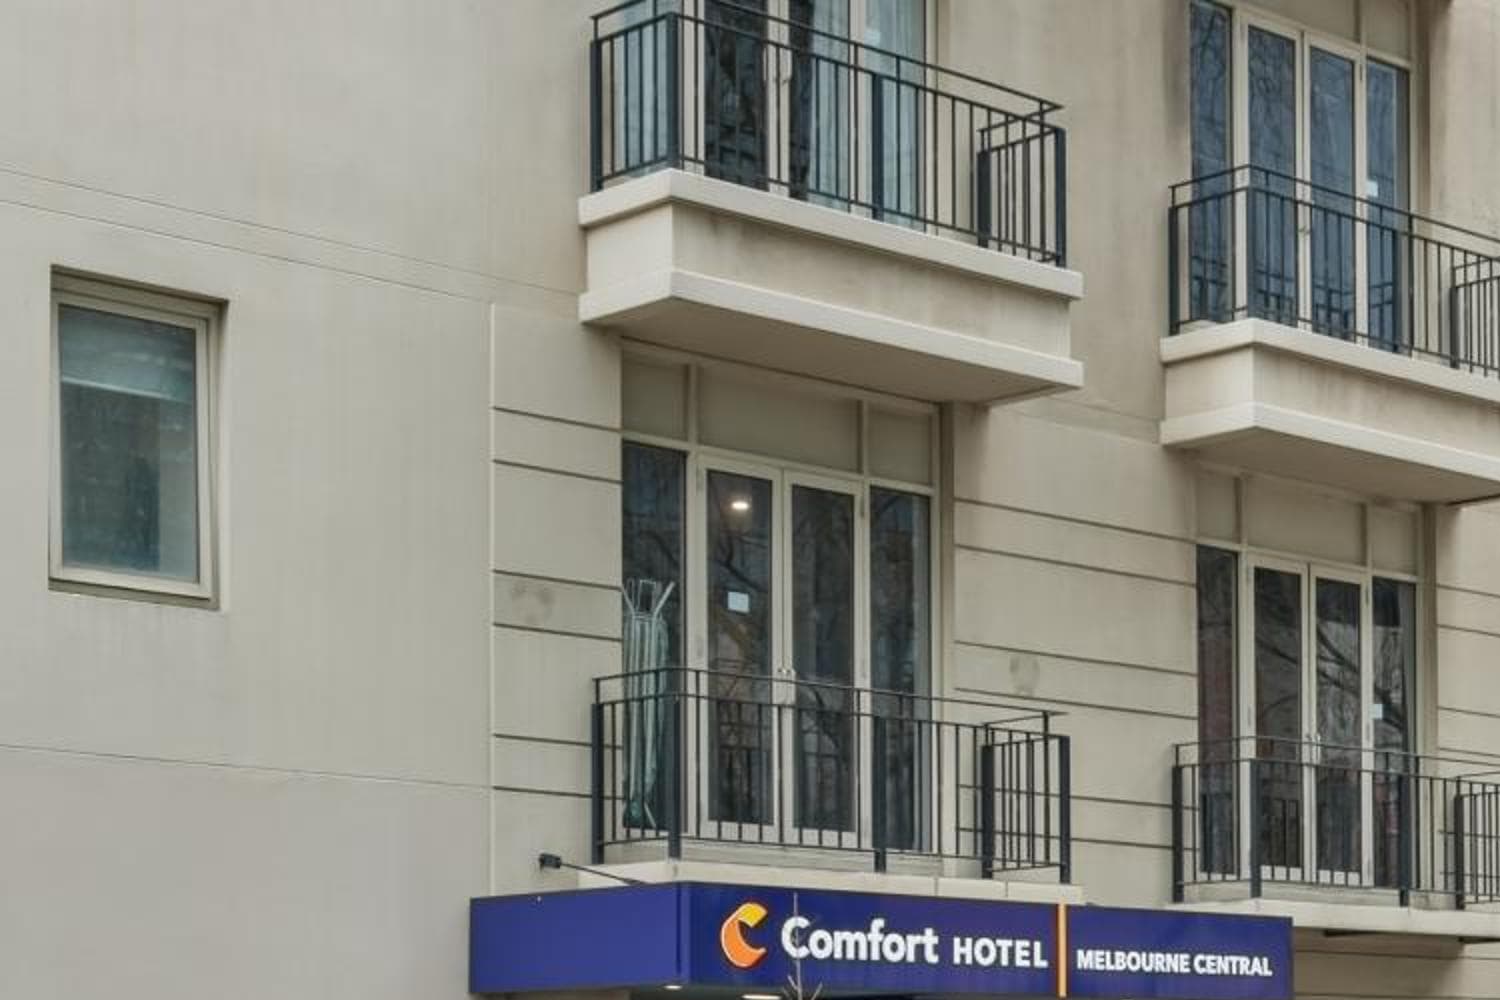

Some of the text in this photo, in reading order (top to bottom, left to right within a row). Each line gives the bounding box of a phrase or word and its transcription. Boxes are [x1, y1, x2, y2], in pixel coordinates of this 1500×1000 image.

[781, 916, 1049, 968] Comfort HOTEL
[1076, 949, 1273, 977] MELBOURNE CENTRAL
